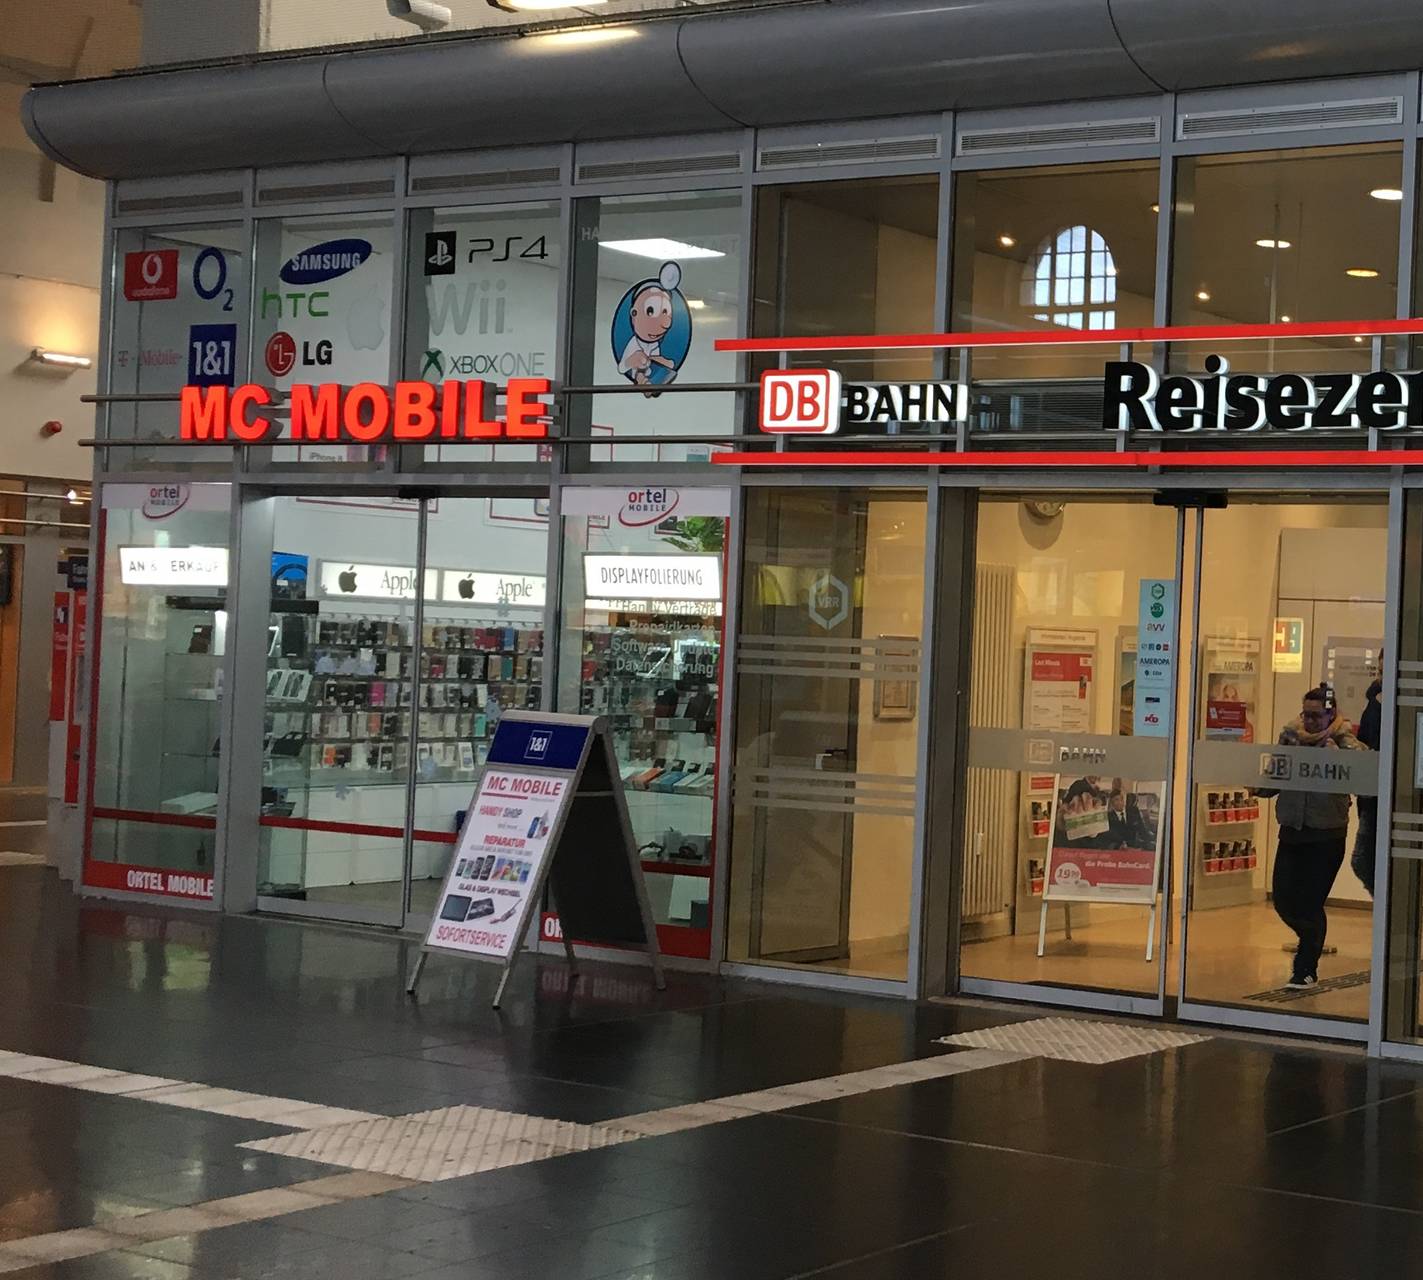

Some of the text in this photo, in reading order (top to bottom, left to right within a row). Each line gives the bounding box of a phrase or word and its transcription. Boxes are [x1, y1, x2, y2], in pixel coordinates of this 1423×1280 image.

[468, 236, 549, 263] PS4
[291, 251, 362, 273] SAMSUNG
[426, 280, 508, 336] Wii
[193, 340, 231, 376] 1&1
[302, 340, 333, 366] LG
[180, 378, 552, 441] MC MOBILE
[769, 380, 962, 422] DB BAHN
[150, 485, 180, 499] ortel
[628, 488, 667, 504] ortel
[628, 504, 666, 512] MOBILE
[129, 561, 145, 572] AN
[168, 561, 221, 573] ERKAUF
[601, 567, 703, 586] DISPLAYFOLIERUNG
[496, 578, 533, 601] Apple
[529, 736, 548, 752] 1&1
[1299, 762, 1352, 780] BAHN
[487, 775, 563, 796] MC MOBILE
[502, 808, 523, 818] SHOP
[484, 835, 527, 848] REPARATUR
[127, 870, 214, 897] ORTEL MOBILE
[436, 925, 508, 950] SOFORTSERVICE
